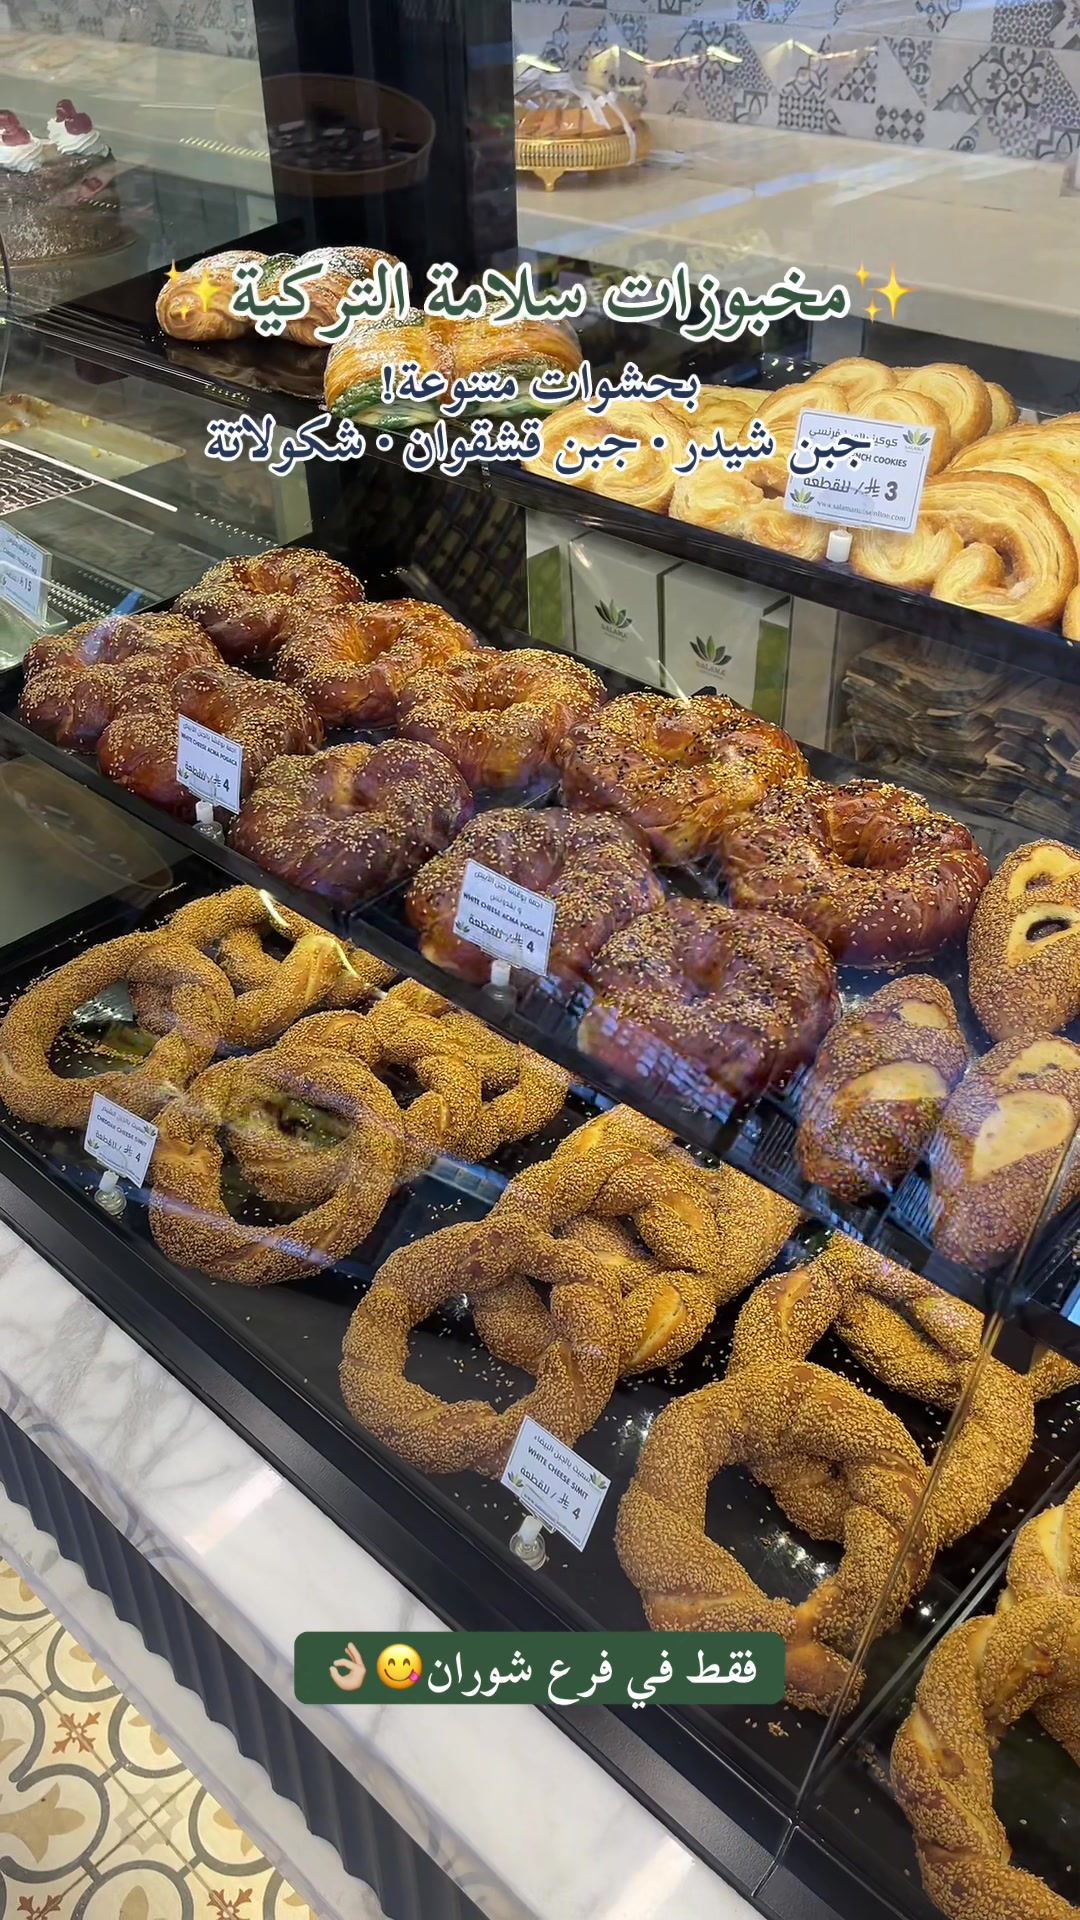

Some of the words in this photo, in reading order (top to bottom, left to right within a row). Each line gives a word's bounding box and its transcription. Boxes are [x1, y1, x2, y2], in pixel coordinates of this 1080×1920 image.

[873, 455, 908, 468] COOKIES
[884, 480, 899, 502] 3
[223, 779, 230, 792] 4
[480, 901, 501, 917] CHEESE
[526, 940, 535, 953] 4
[135, 1152, 141, 1162] 4
[527, 1445, 547, 1467] WHITE
[547, 1462, 571, 1485] CHEESE
[571, 1481, 589, 1500] SIMIT
[572, 1506, 581, 1520] 4
